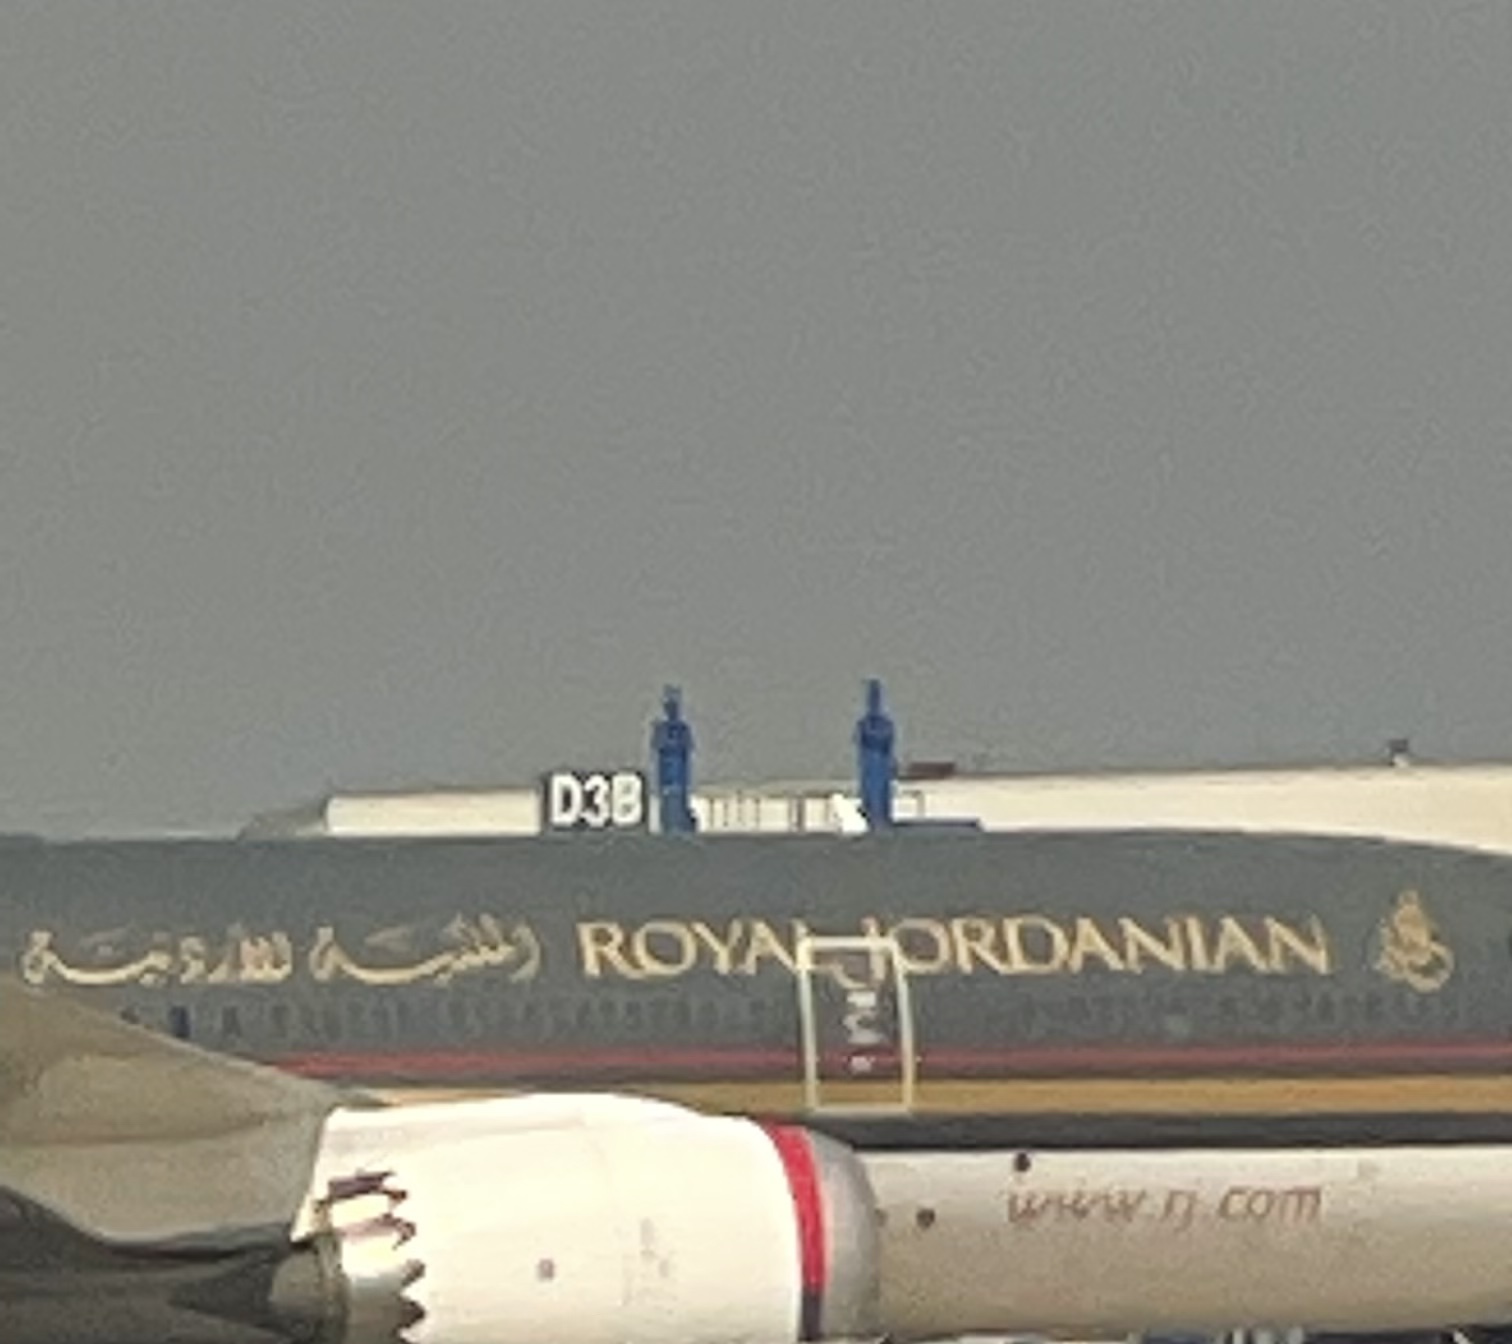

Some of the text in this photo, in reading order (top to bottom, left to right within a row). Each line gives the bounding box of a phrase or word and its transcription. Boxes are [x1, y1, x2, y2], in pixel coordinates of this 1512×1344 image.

[550, 773, 642, 826] D3B
[576, 915, 1331, 988] ROYAL JORDANIAN
